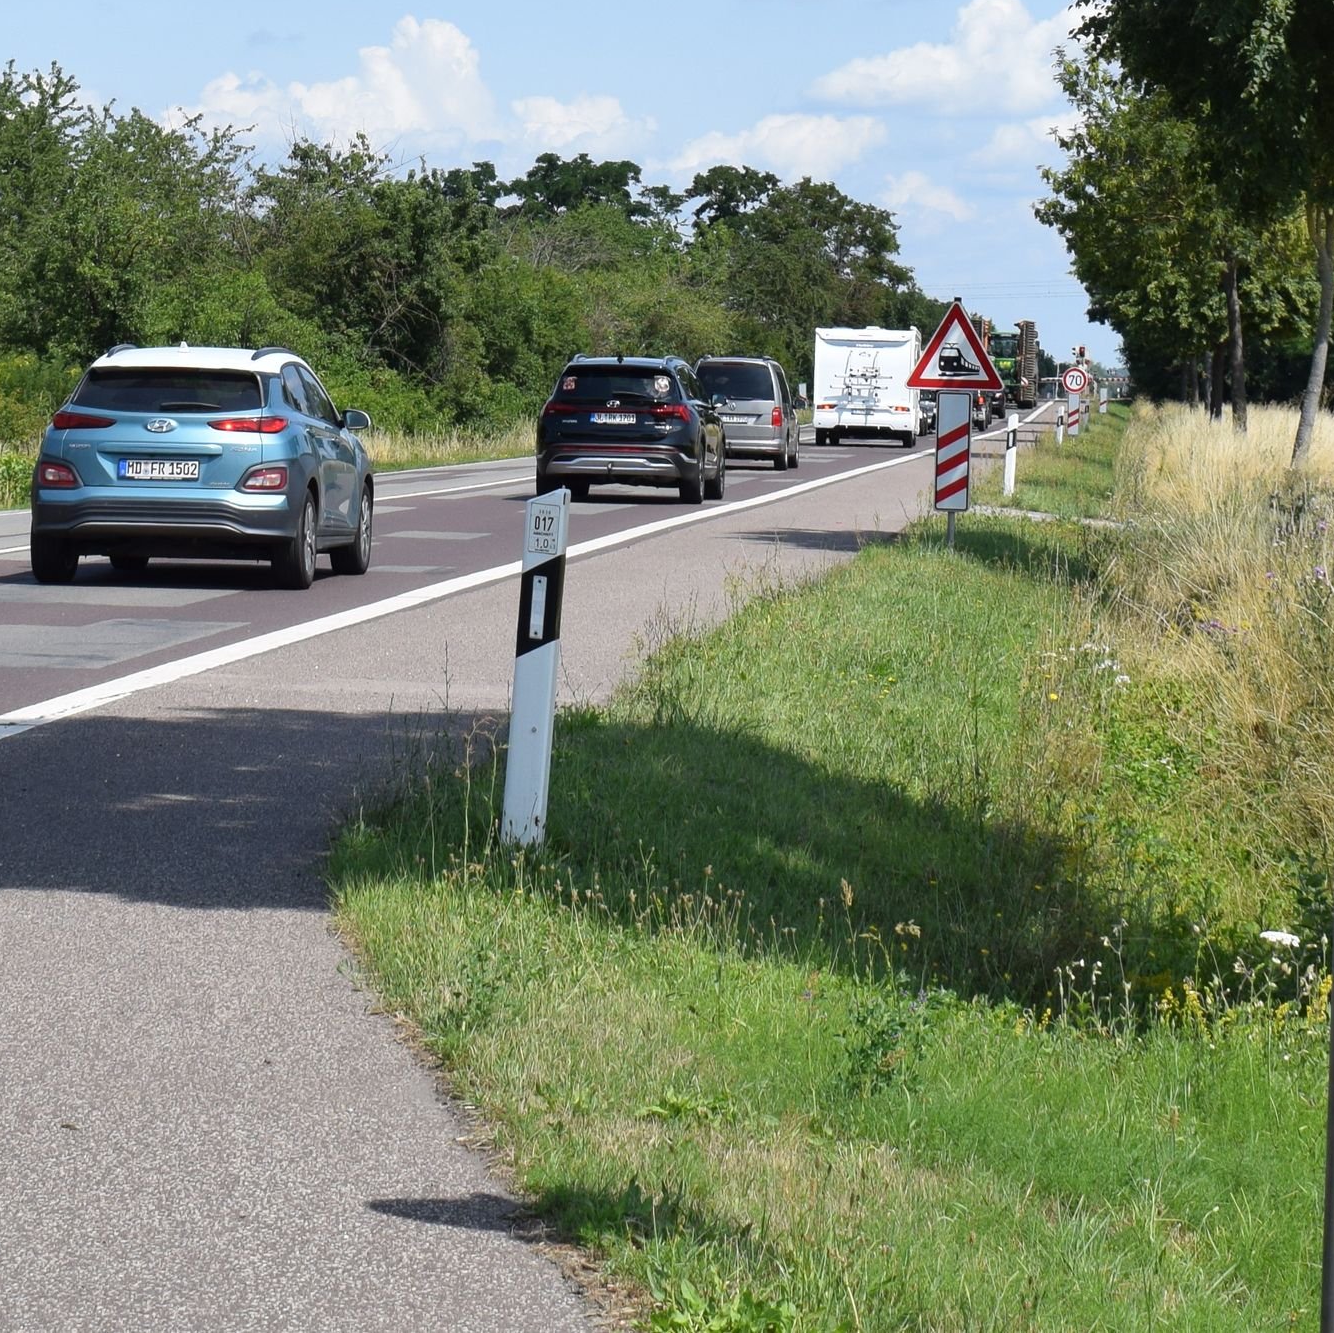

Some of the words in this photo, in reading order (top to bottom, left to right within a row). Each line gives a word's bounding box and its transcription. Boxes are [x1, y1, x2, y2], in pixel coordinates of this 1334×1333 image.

[1068, 374, 1082, 386] 70
[127, 461, 142, 475] MD
[151, 462, 165, 475] FR
[168, 462, 197, 476] 1502
[534, 516, 554, 532] 017
[535, 538, 549, 549] 1.0
